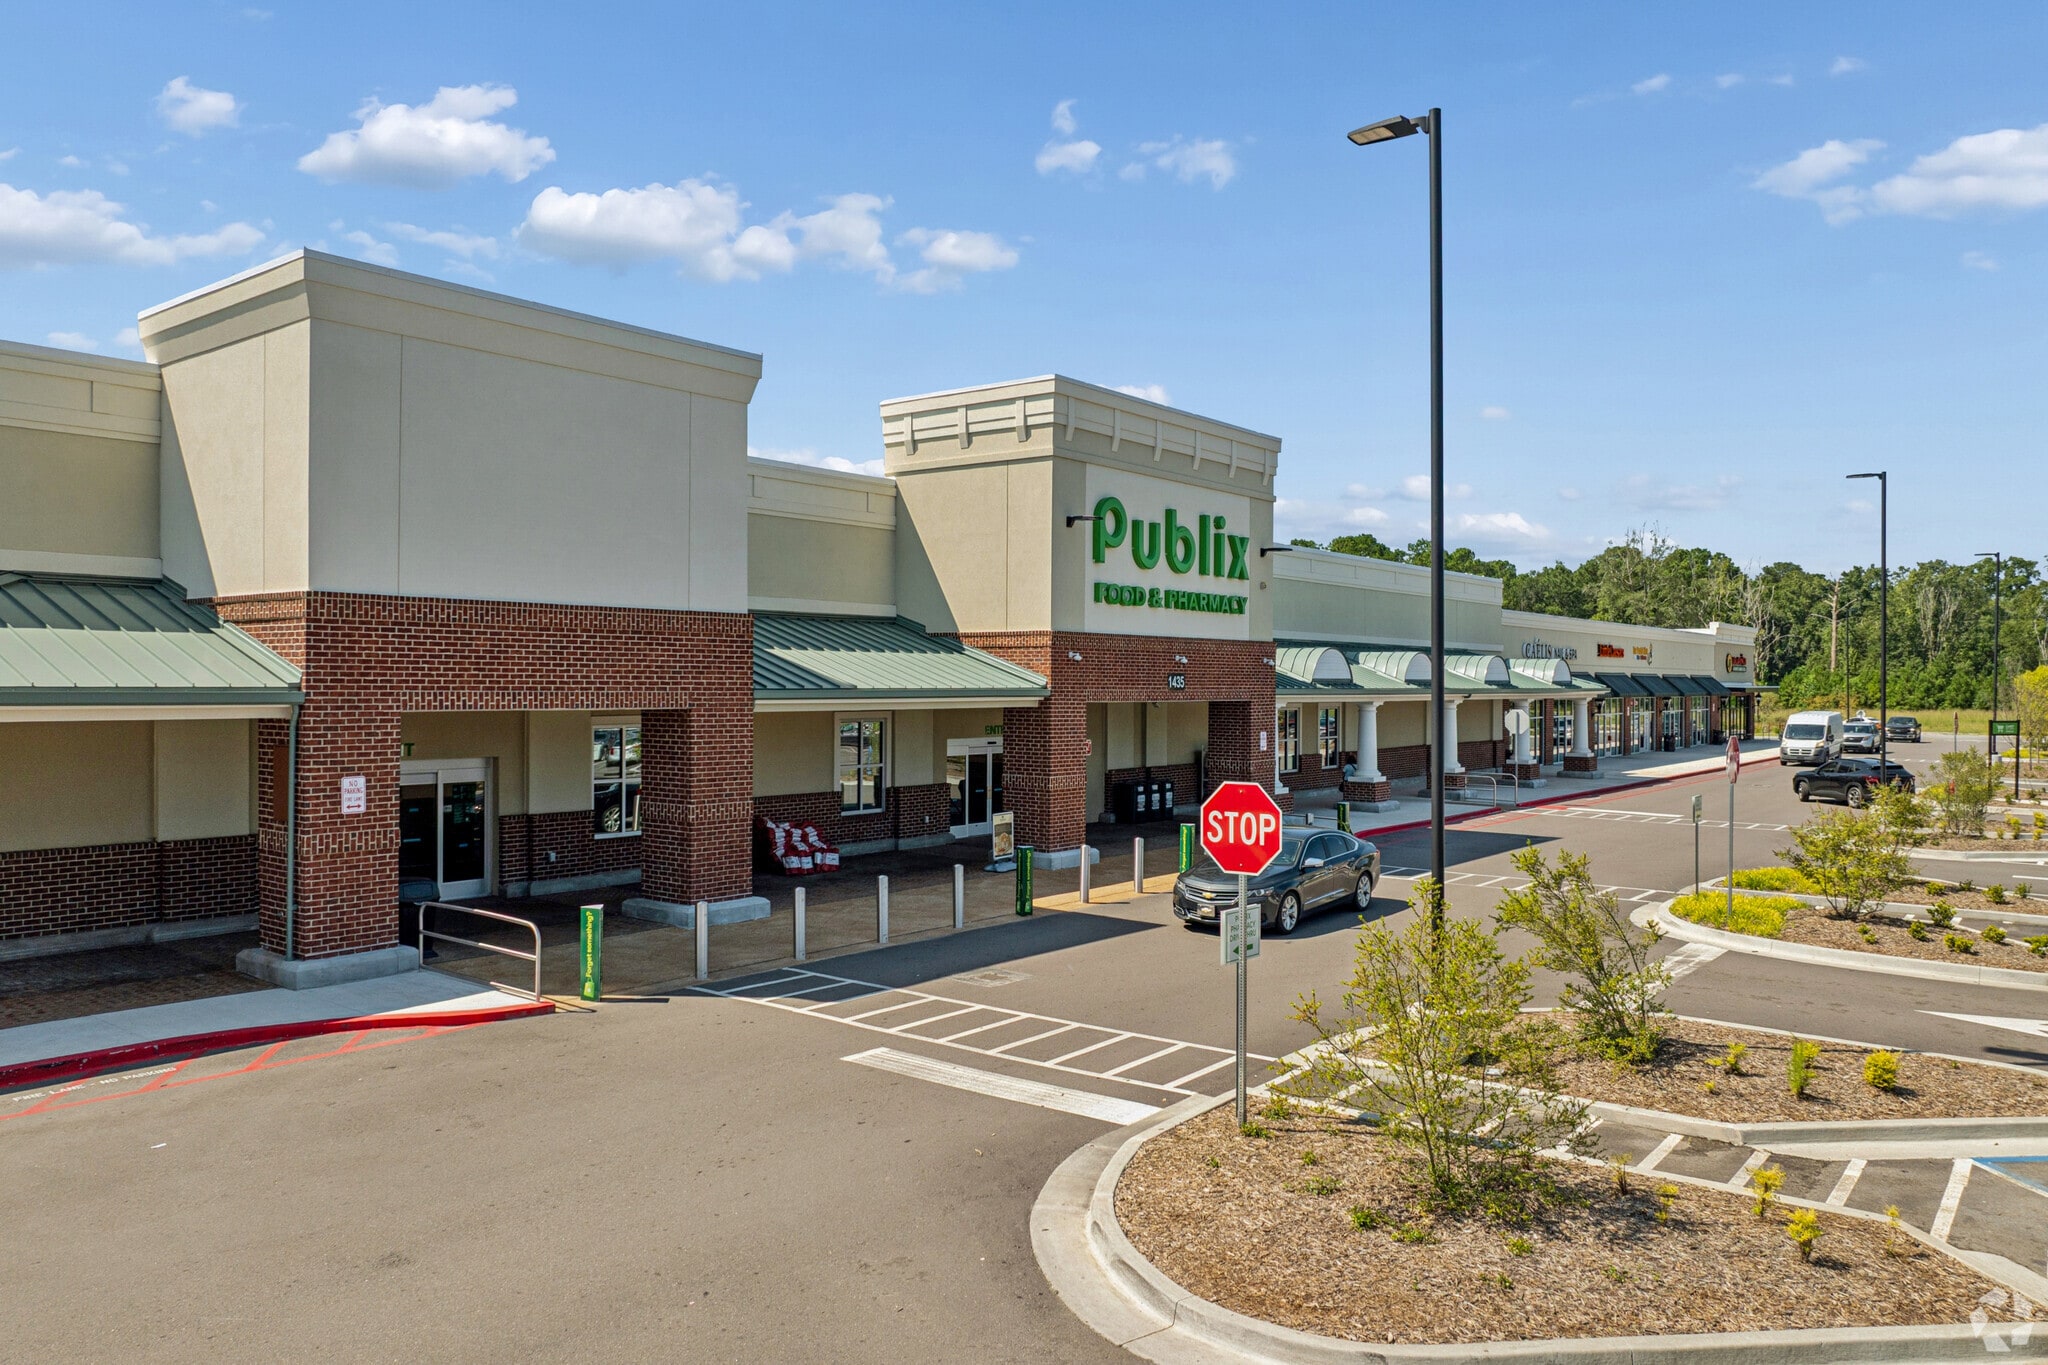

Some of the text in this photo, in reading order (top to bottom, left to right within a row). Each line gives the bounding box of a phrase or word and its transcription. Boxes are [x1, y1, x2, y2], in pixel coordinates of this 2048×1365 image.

[1092, 496, 1250, 580] Publix
[1093, 582, 1248, 614] FOOD & PHARMACY
[1168, 675, 1185, 688] 1435
[985, 724, 1003, 735] ENT
[1206, 810, 1276, 846] STOP
[585, 911, 594, 978] Forget something?
[12, 1092, 46, 1102] FIRE
[49, 1084, 86, 1095] LANE
[122, 1066, 177, 1080] PARKING
